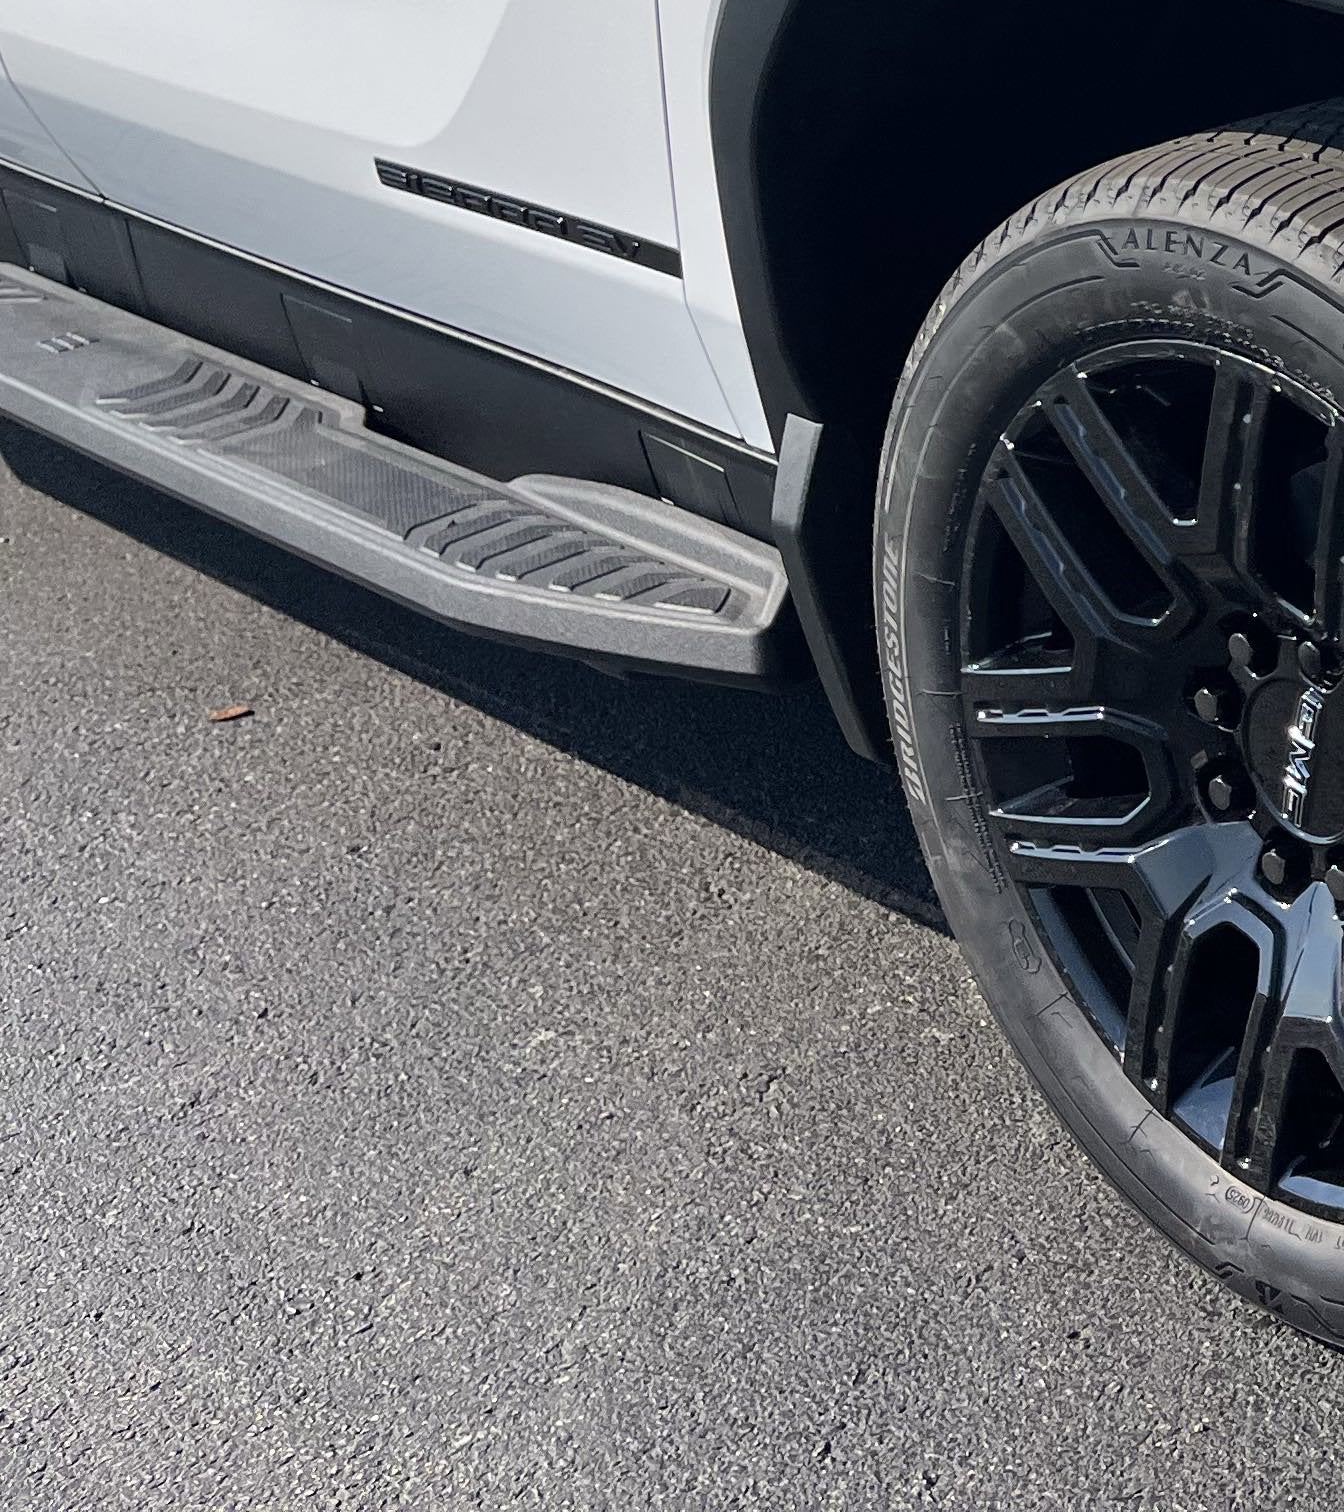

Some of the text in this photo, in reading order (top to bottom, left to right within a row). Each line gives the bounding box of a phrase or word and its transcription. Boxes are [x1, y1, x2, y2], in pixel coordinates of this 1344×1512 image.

[376, 163, 641, 259] SIERRA EV
[1121, 227, 1251, 276] ALENZA
[882, 531, 928, 806] BRIDGESTONE
[1281, 687, 1325, 828] GMC
